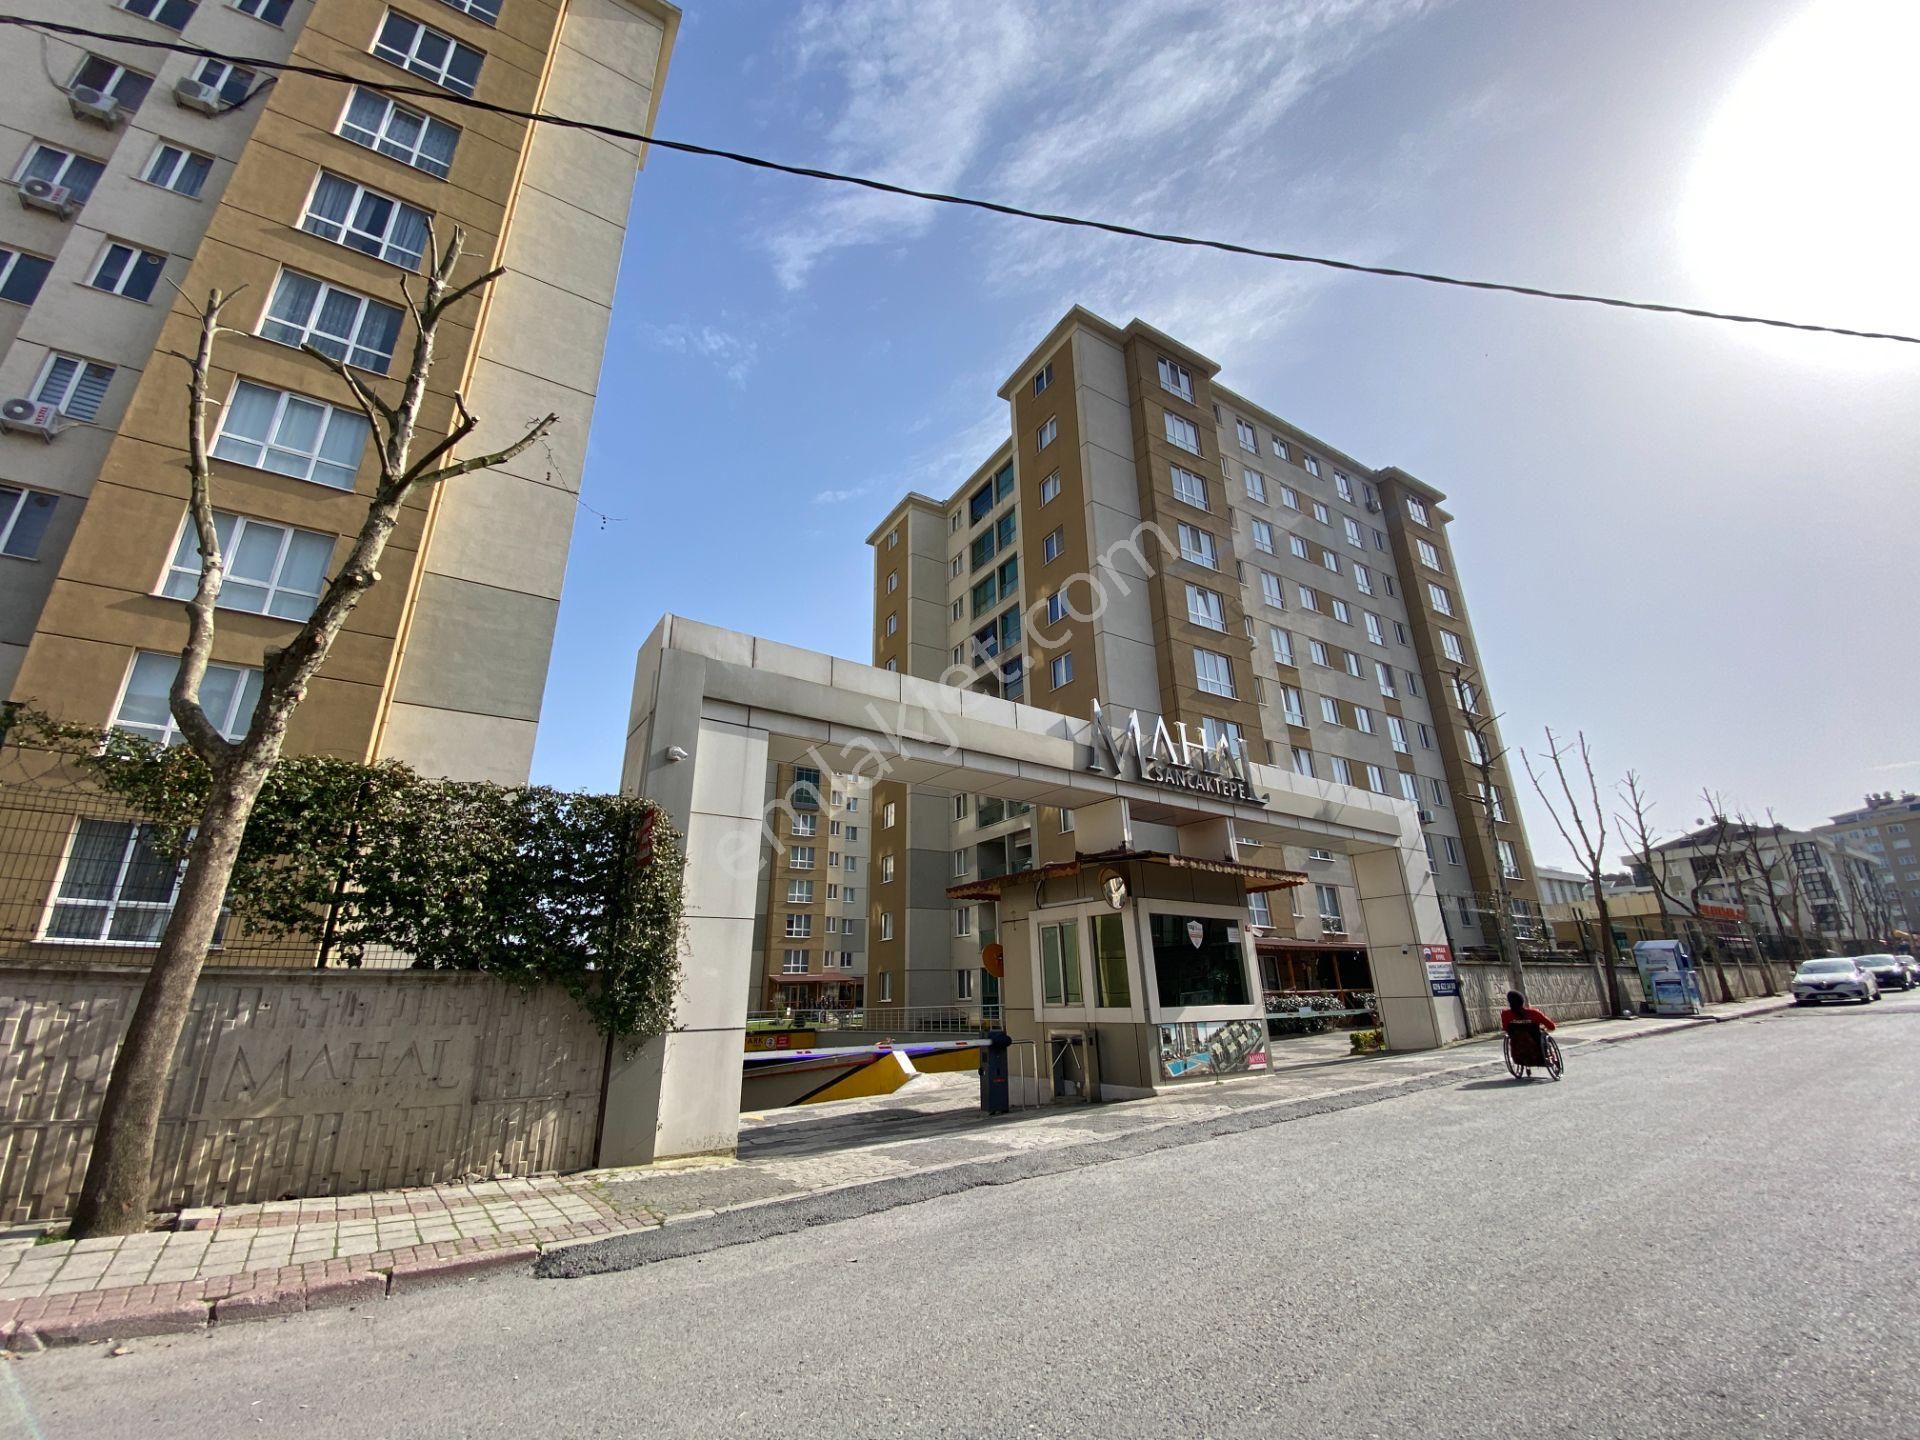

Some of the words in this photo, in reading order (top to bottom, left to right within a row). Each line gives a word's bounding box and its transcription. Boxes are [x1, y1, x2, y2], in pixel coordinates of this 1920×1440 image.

[1088, 697, 1270, 808] MAHAL
[1155, 767, 1246, 799] SANCAKTEPE
[221, 1039, 461, 1102] MAHAL
